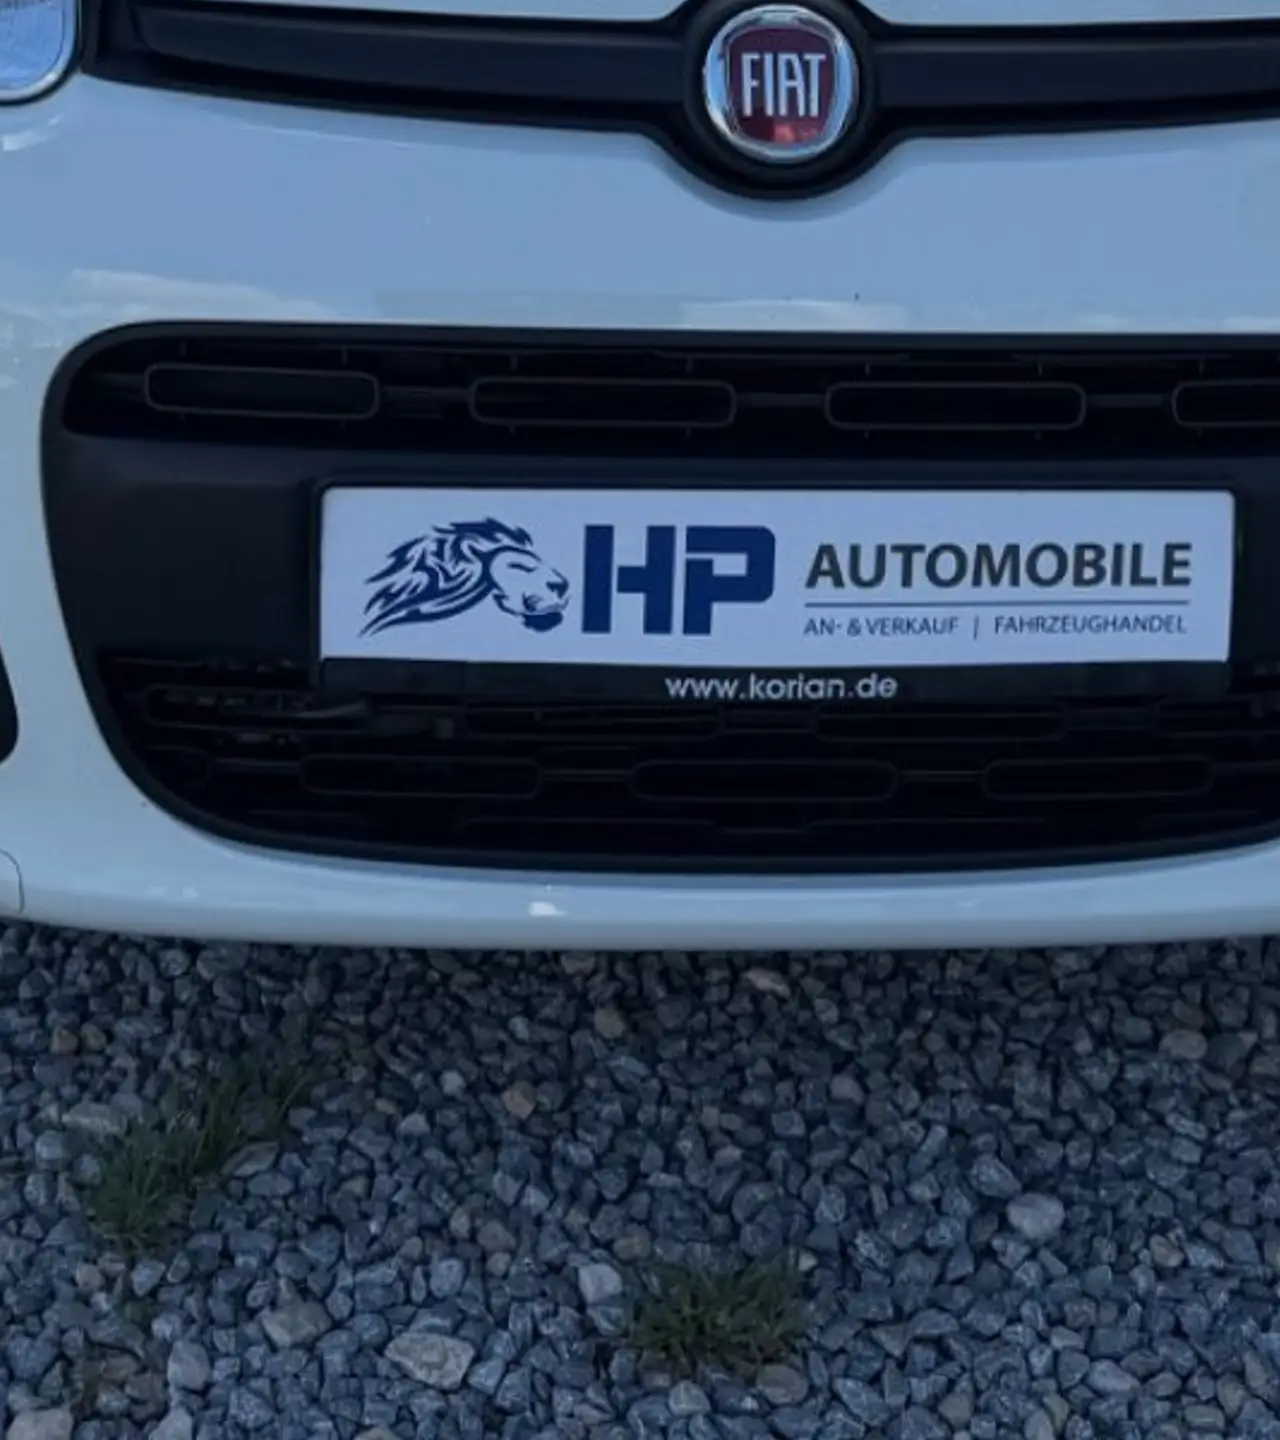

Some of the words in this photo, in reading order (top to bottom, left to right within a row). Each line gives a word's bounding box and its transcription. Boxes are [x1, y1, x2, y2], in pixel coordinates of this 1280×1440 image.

[741, 53, 826, 117] FIAT
[581, 524, 777, 636] HP
[804, 542, 1193, 590] AUTOMOBILE
[803, 617, 844, 637] AN-
[846, 617, 862, 638] &
[866, 615, 960, 637] VERKAUF
[993, 613, 1188, 636] FAHRZEUGHANDEL
[664, 672, 899, 703] www.korian.de
